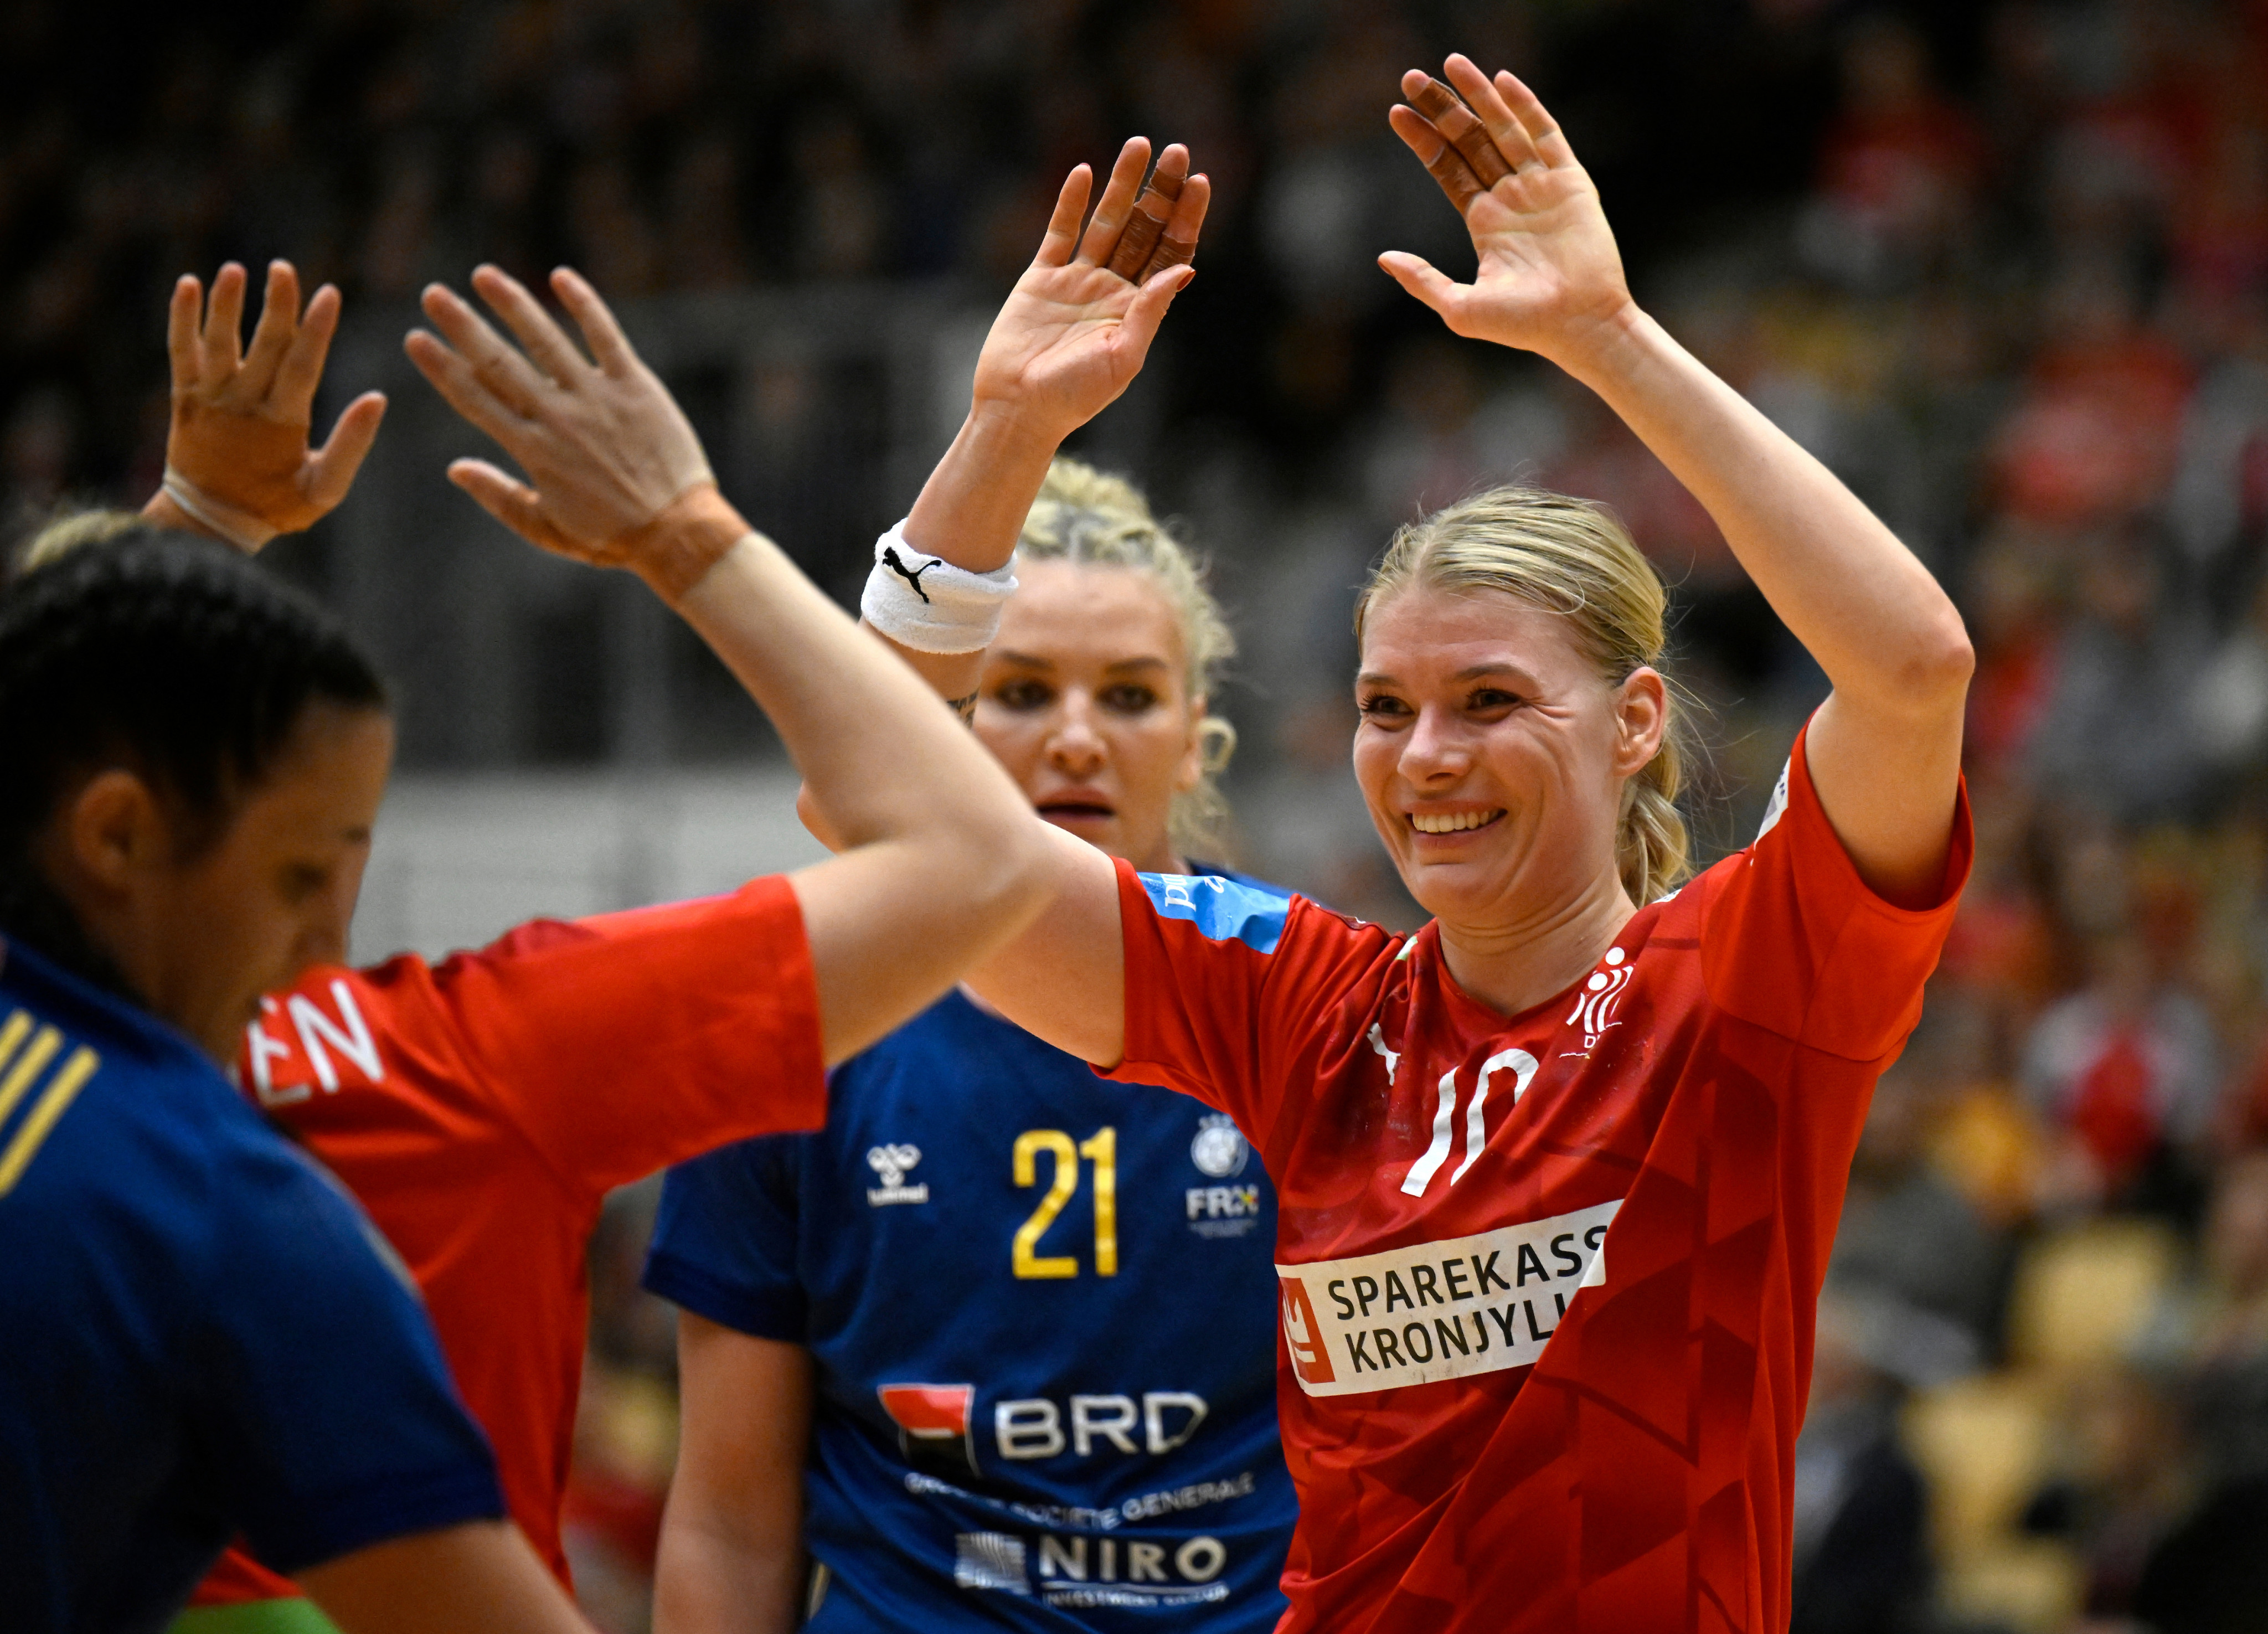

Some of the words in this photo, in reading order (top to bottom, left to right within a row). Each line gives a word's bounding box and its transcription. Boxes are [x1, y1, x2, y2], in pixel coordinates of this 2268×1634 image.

[1400, 1048, 1540, 1198] 10
[1011, 1126, 1118, 1280] 21
[994, 1391, 1209, 1460] BRD
[1038, 1534, 1226, 1582] NIRO
